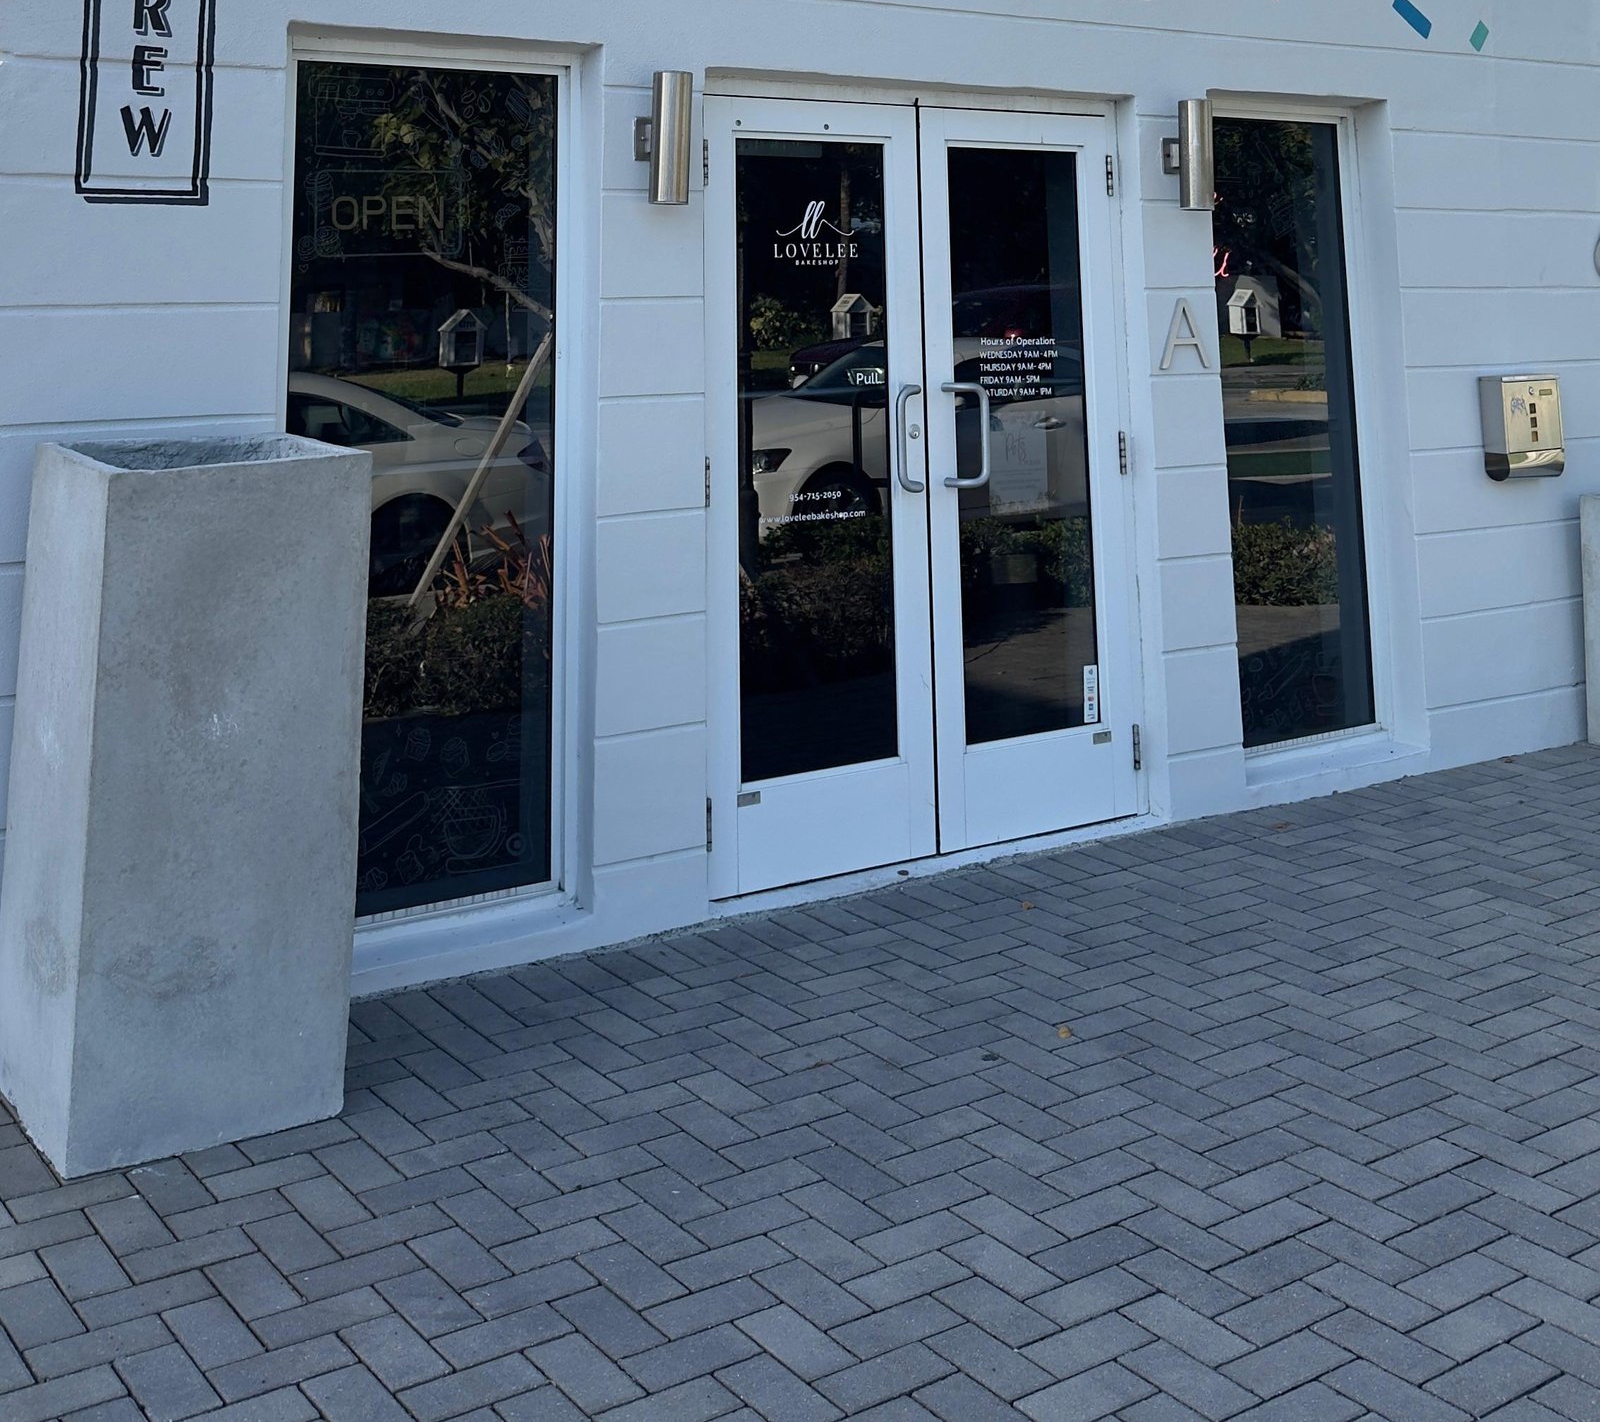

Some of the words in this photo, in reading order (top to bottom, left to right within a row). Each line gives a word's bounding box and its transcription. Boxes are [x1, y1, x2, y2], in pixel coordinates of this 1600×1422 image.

[331, 195, 446, 230] OPEN
[773, 243, 859, 259] LOVELEE
[1159, 297, 1210, 370] A
[980, 336, 1004, 346] Hours
[1005, 335, 1015, 346] of
[979, 350, 1023, 359] WEDNESDAY
[980, 363, 1016, 372] THURSDAY
[856, 372, 879, 385] Pull
[980, 375, 1005, 384] FRIDAY
[985, 388, 1018, 397] ATURDAY
[789, 490, 842, 502] 954-715-2050
